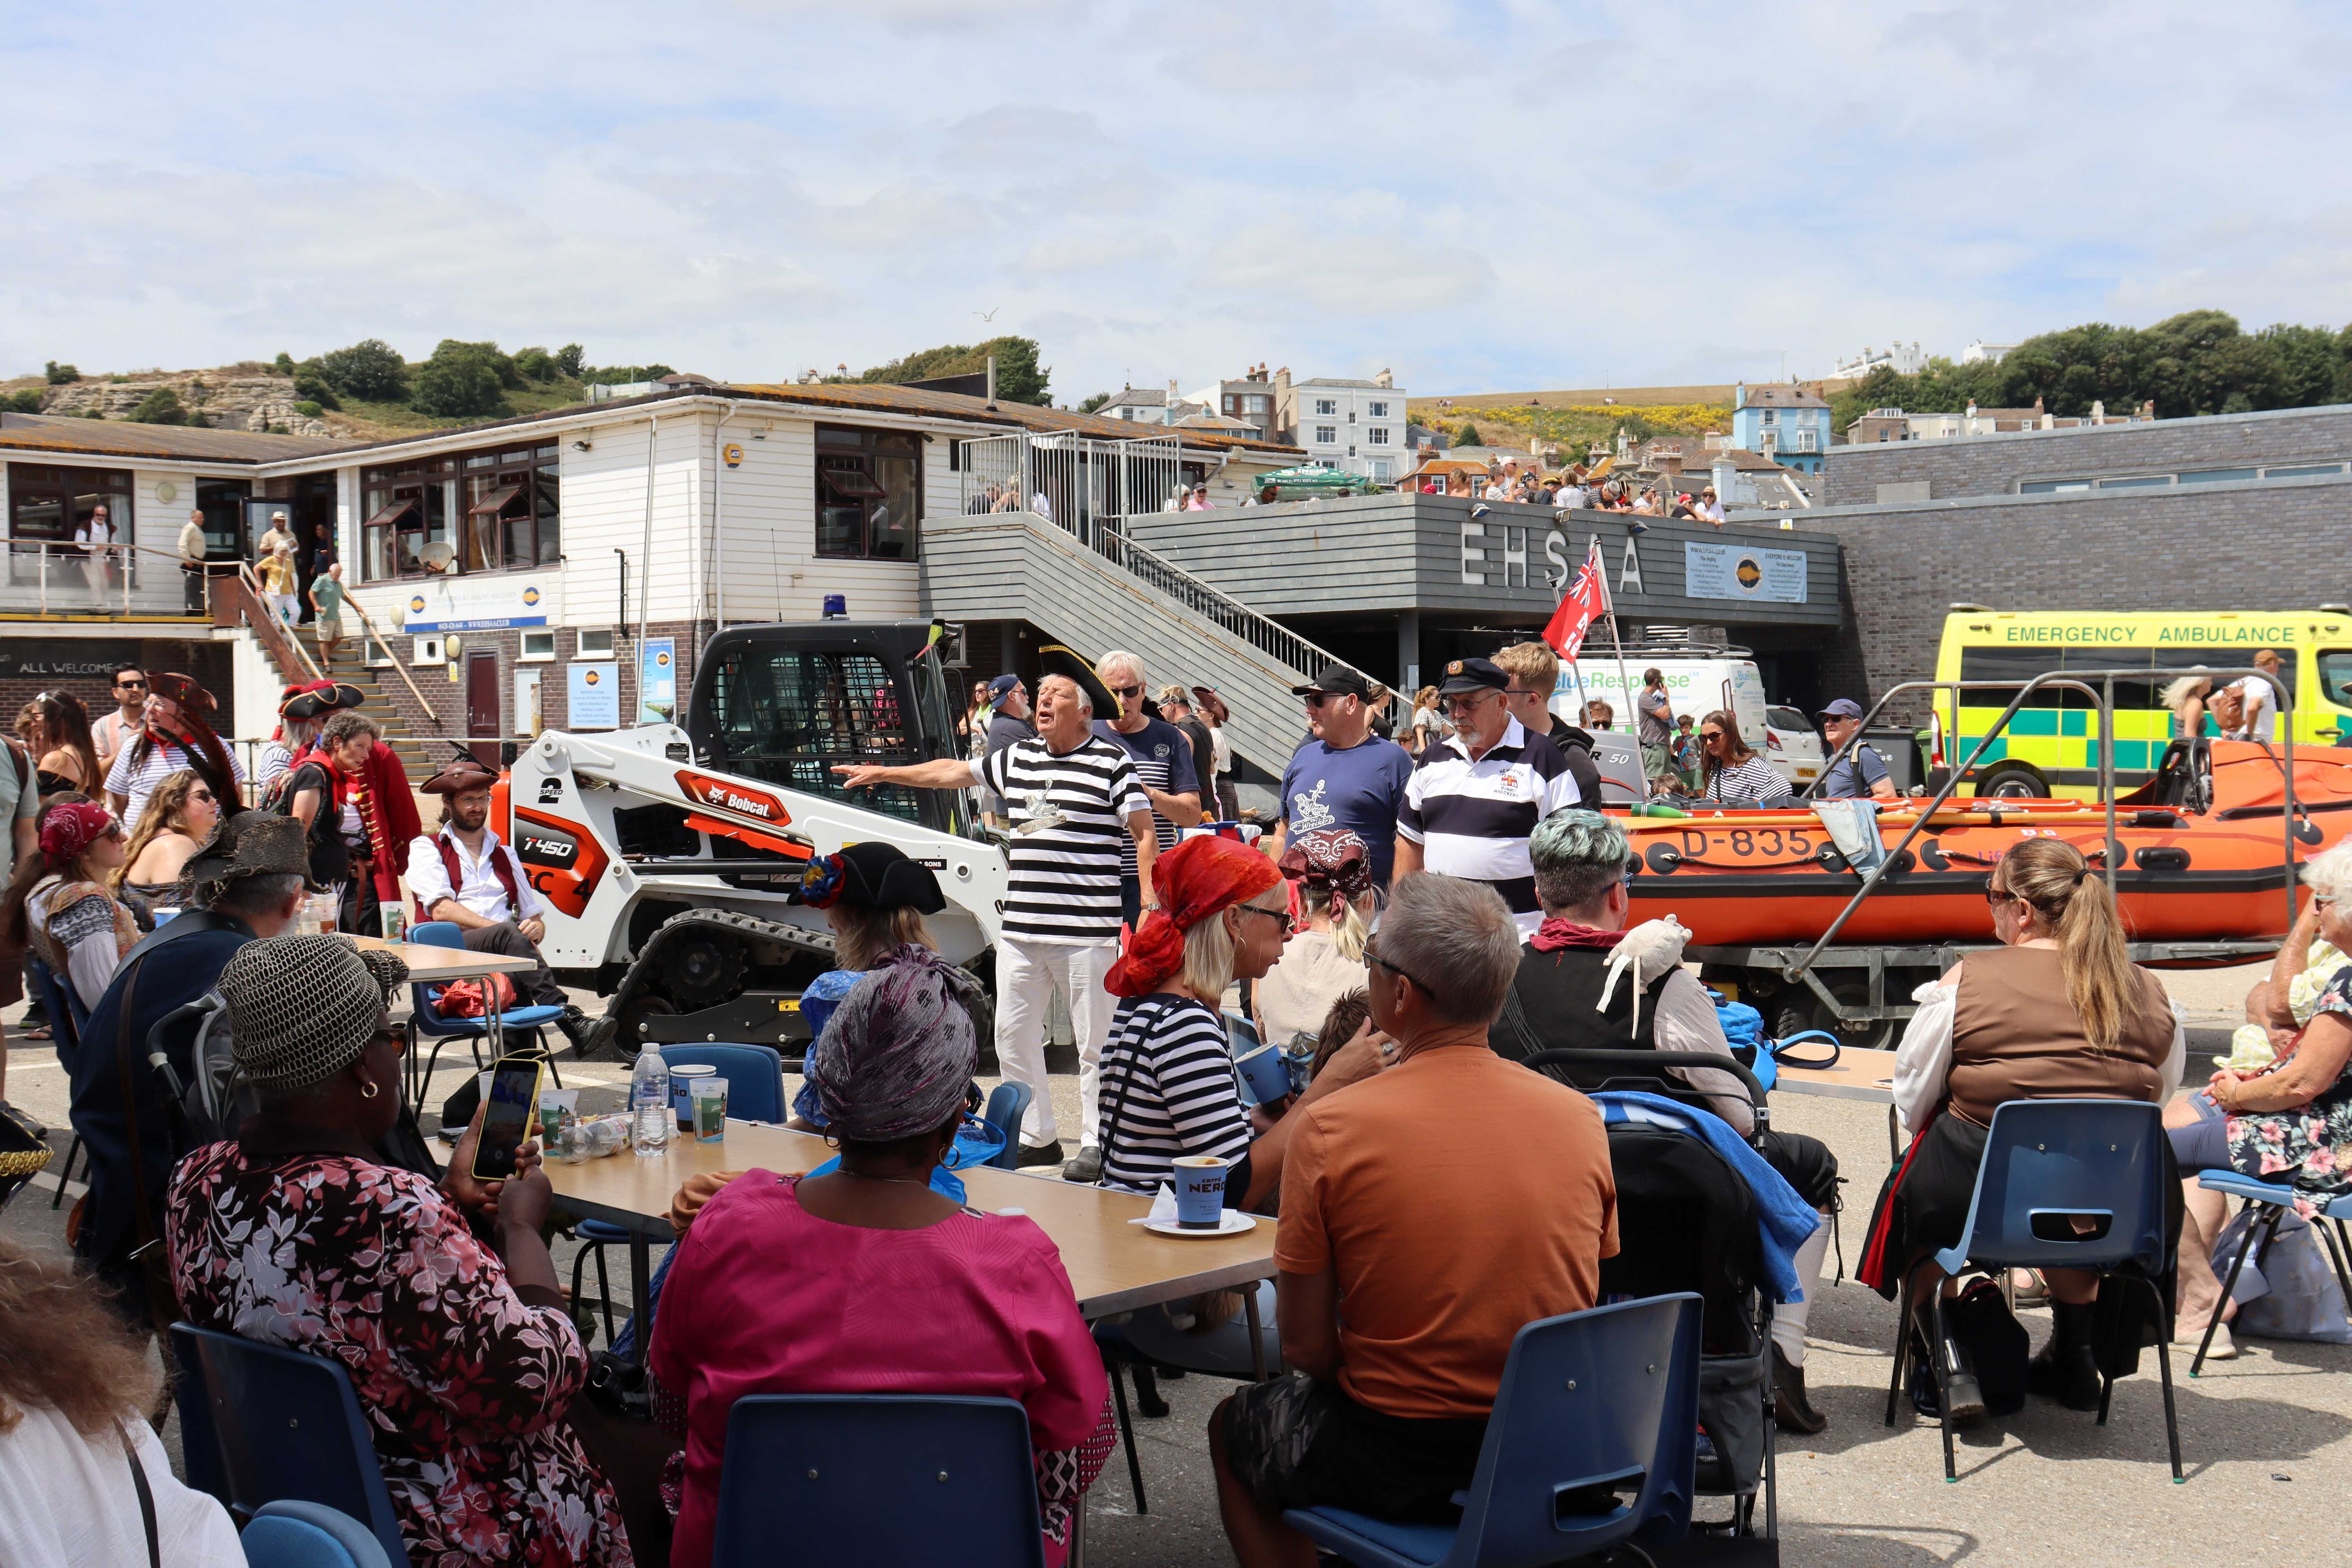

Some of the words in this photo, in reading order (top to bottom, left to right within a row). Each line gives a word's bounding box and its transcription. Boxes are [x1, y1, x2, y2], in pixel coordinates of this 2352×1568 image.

[1461, 522, 1643, 593] EHSA
[2007, 627, 2138, 642] EMERGENCY
[2158, 627, 2295, 642] AMBULANCE
[20, 663, 47, 673] ALL
[52, 662, 113, 673] WELCOME
[1609, 753, 1630, 764] 50
[1499, 768, 1524, 777] NEWHAVEN
[538, 777, 562, 804] 2
[1494, 789, 1519, 798] WRECKERS
[728, 793, 769, 817] Bobcat
[1302, 818, 1332, 829] Wreckers
[524, 837, 573, 857] T450
[1682, 829, 1811, 857] D-835
